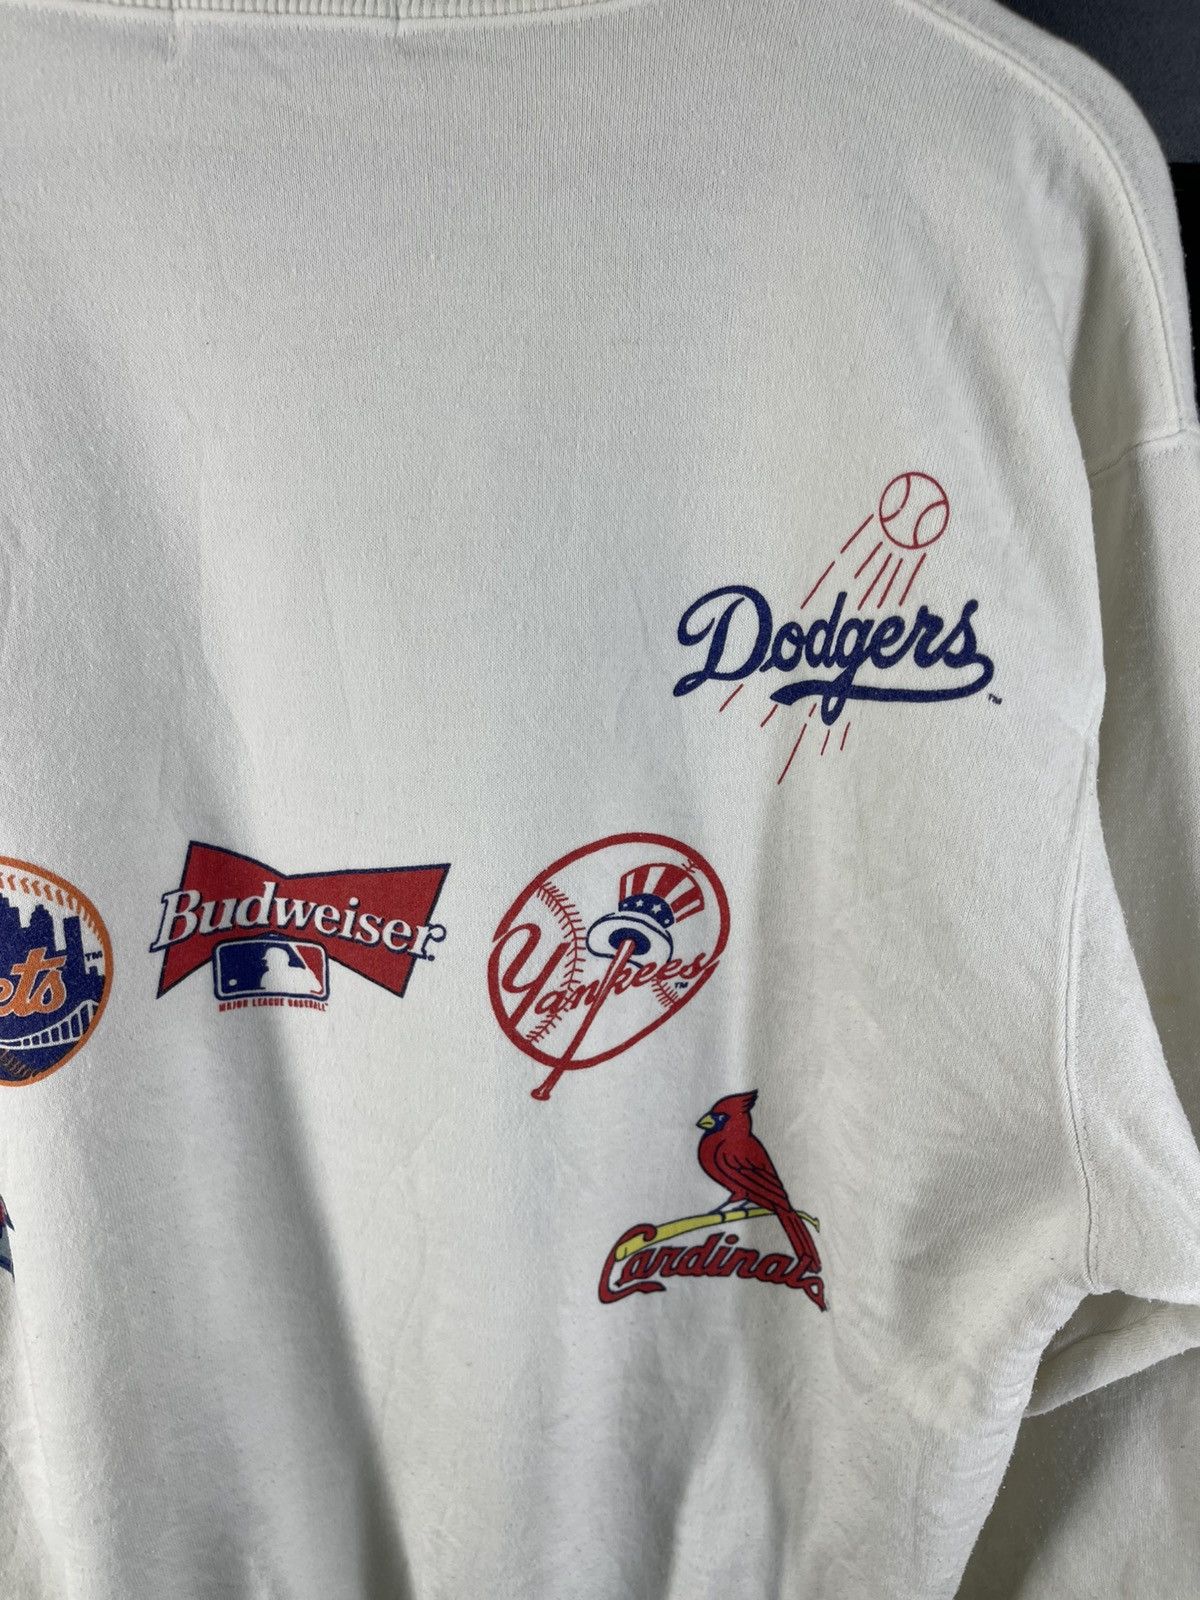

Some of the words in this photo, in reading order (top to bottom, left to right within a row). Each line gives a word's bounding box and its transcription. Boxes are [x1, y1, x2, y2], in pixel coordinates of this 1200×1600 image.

[673, 585, 995, 726] Dodgers
[252, 998, 284, 1007] LEAGUE
[499, 922, 708, 1027] Yankees
[599, 1223, 828, 1312] Cardinals
